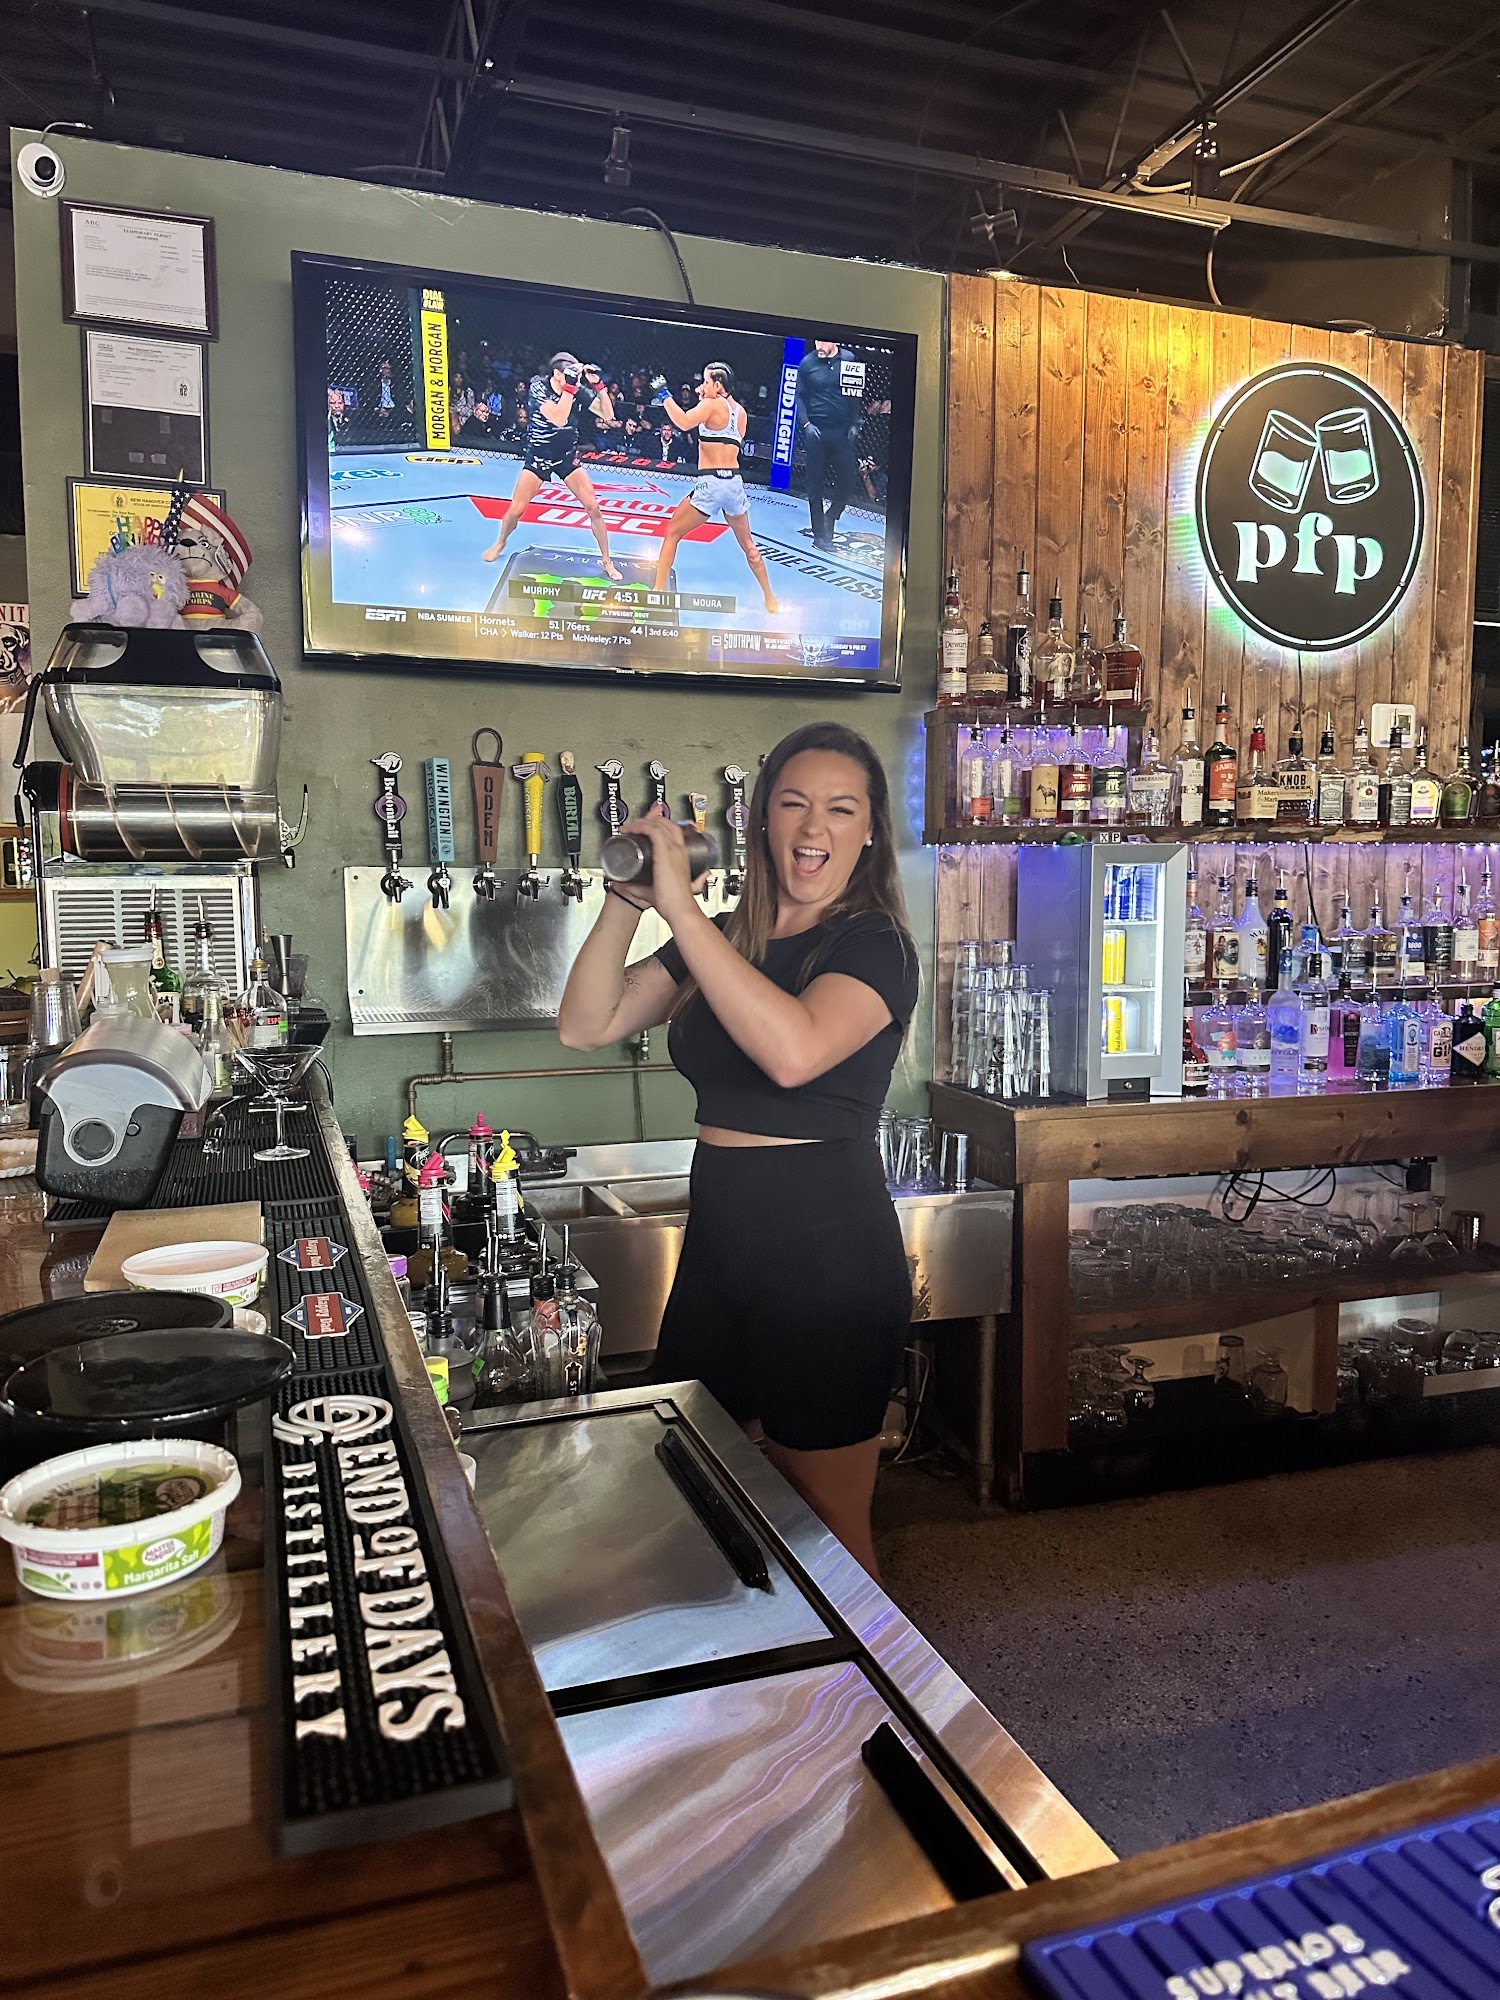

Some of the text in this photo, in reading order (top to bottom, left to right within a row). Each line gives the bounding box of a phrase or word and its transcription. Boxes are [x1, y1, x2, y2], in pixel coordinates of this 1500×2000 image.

[423, 289, 444, 301] DIAL
[428, 323, 446, 440] MORGAN & MORGAN
[845, 364, 861, 373] UFC
[842, 387, 863, 397] LIVE
[776, 367, 799, 463] BUD LIGHT
[531, 488, 679, 515] Avator
[1232, 512, 1384, 595] pfp
[190, 591, 214, 600] ARINE
[522, 585, 561, 596] MURPHY
[582, 589, 608, 601] UFC
[614, 591, 640, 603] 4:51
[693, 598, 722, 608] MOURA
[798, 564, 884, 602] CLASS
[365, 608, 407, 622] ESPN
[418, 612, 472, 623] NBA SUMMER
[479, 616, 560, 630] Hornets 51
[566, 621, 643, 635] 76ers 44
[480, 627, 632, 645] CHA Walker: 12 Pts McNeeley: 7 Pts
[649, 628, 679, 637] 3rd 6:40
[723, 633, 762, 651] SOUTHPAW
[1215, 763, 1237, 772] JAMES
[1280, 774, 1307, 786] KNOB
[383, 777, 400, 839] Broomtail
[426, 772, 436, 832] TROPICAL
[436, 763, 452, 836] WILMINGTON
[484, 776, 494, 847] ODEN
[563, 785, 579, 840] BURIAL
[608, 782, 622, 836] Broomtai
[733, 788, 746, 845] Broomtail
[1101, 834, 1120, 842] X P
[306, 1239, 324, 1267] Happy Dad
[315, 1295, 336, 1333] Happy Dad
[124, 1549, 200, 1585] Margarita Salt
[282, 1460, 348, 1741] DISTILLERY
[337, 1440, 467, 1743] END OF DAYS
